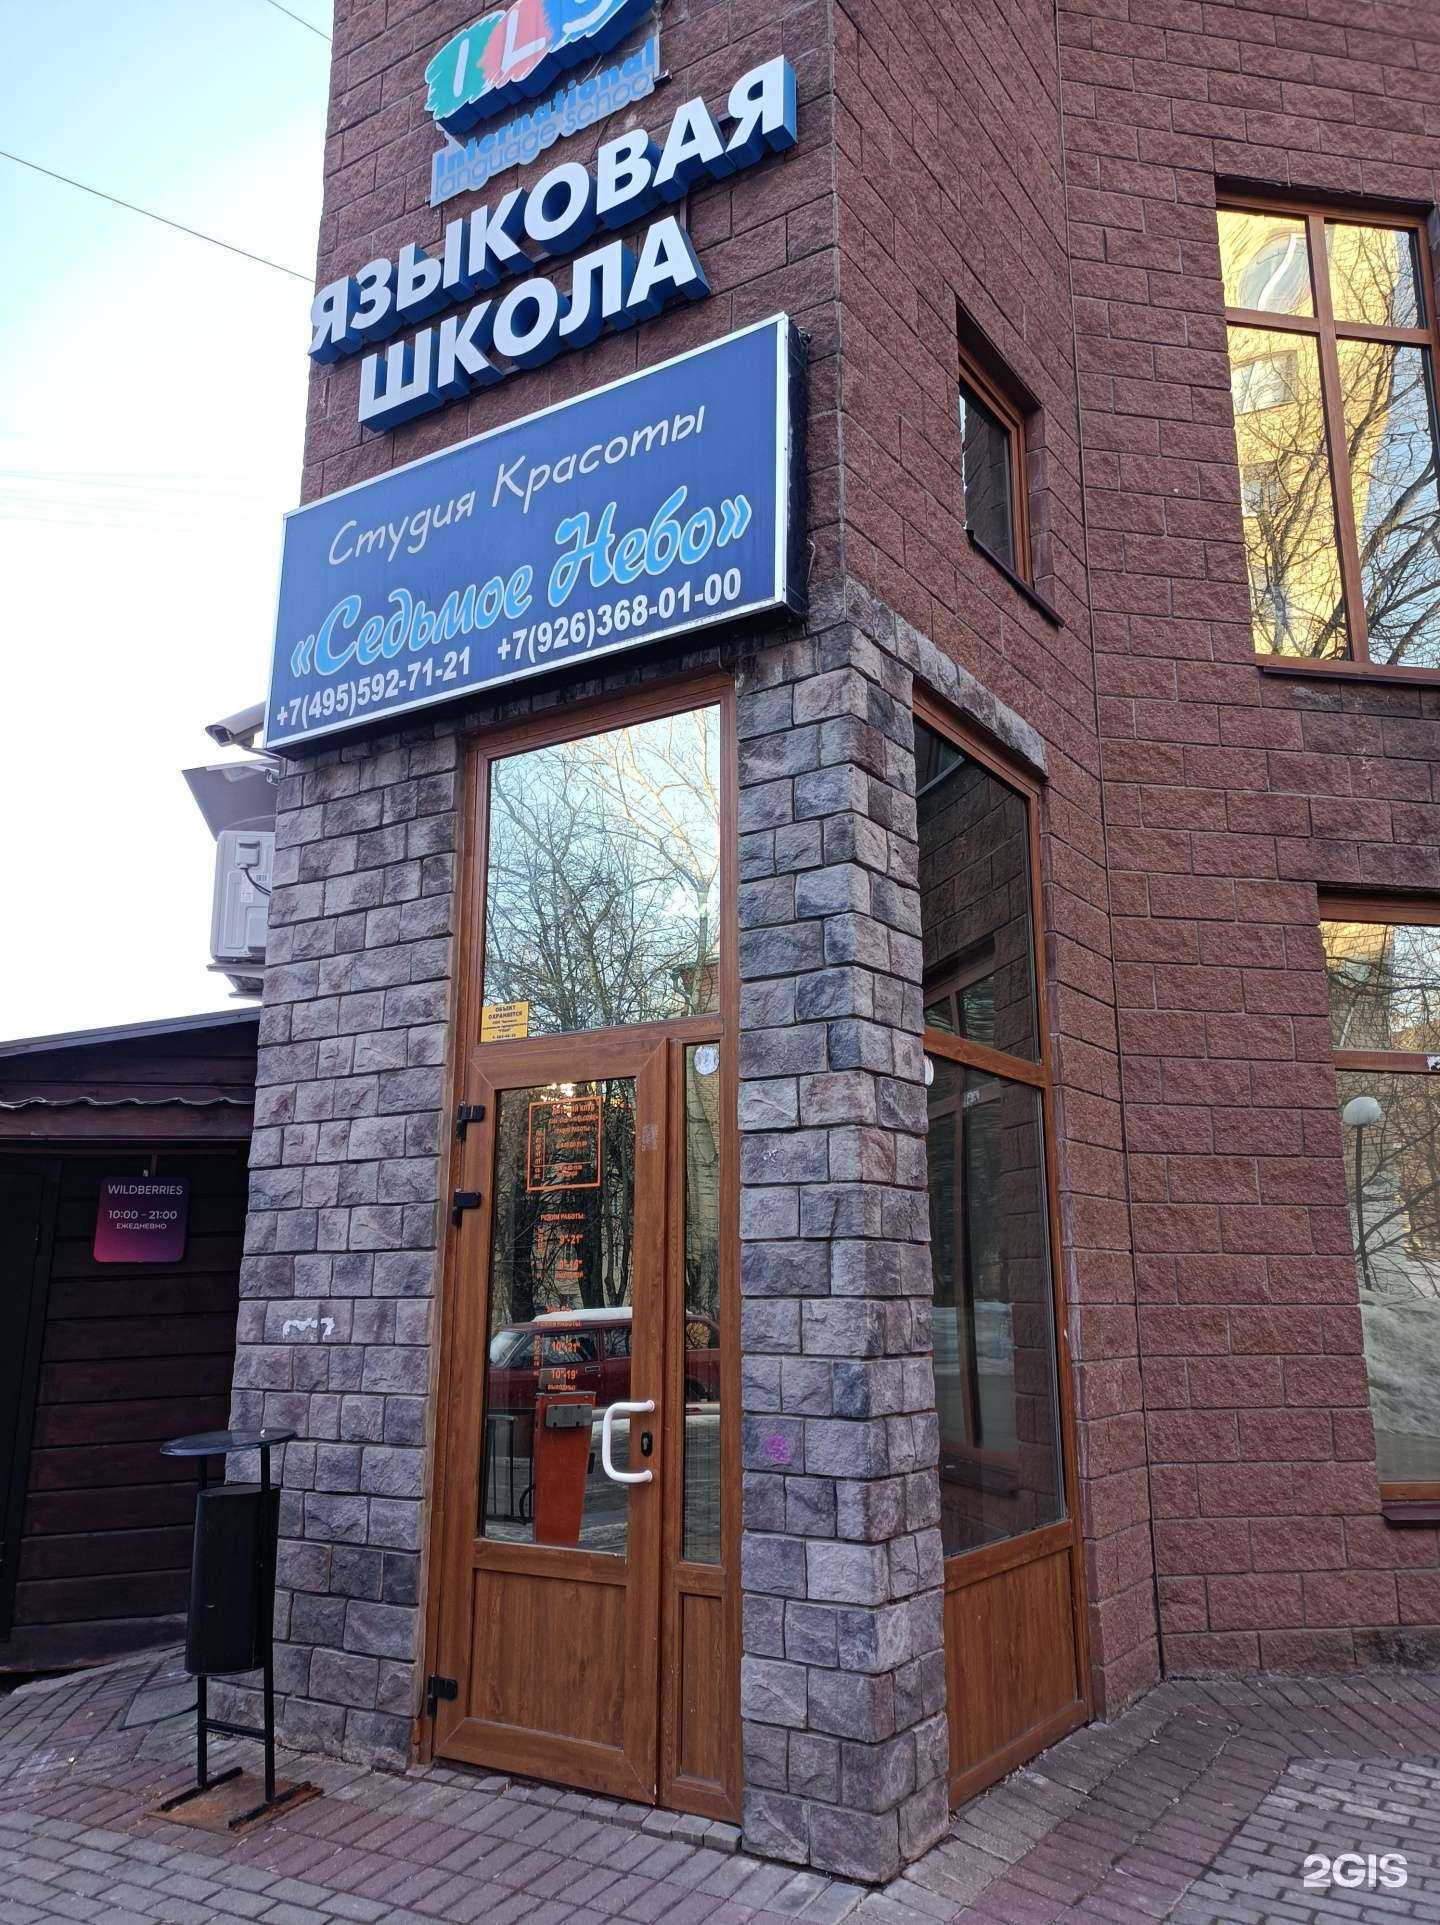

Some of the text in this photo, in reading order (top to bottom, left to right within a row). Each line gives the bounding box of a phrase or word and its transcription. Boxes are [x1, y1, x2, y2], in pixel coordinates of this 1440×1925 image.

[436, 36, 656, 173] International
[307, 54, 790, 358] ЯЗЫКОВАЯ
[357, 215, 696, 424] ШКОЛА
[328, 405, 705, 567] Студия Красоты
[276, 567, 743, 728] +7(495)592-71-21 +7(926)368-01-00
[289, 485, 752, 678] «Седьмое Небо»
[107, 1184, 184, 1196] WILDBERRIES
[108, 1210, 139, 1220] 10:00
[148, 1210, 178, 1220] 21:00
[116, 1222, 168, 1230] ЕЖЕДНЕВНО
